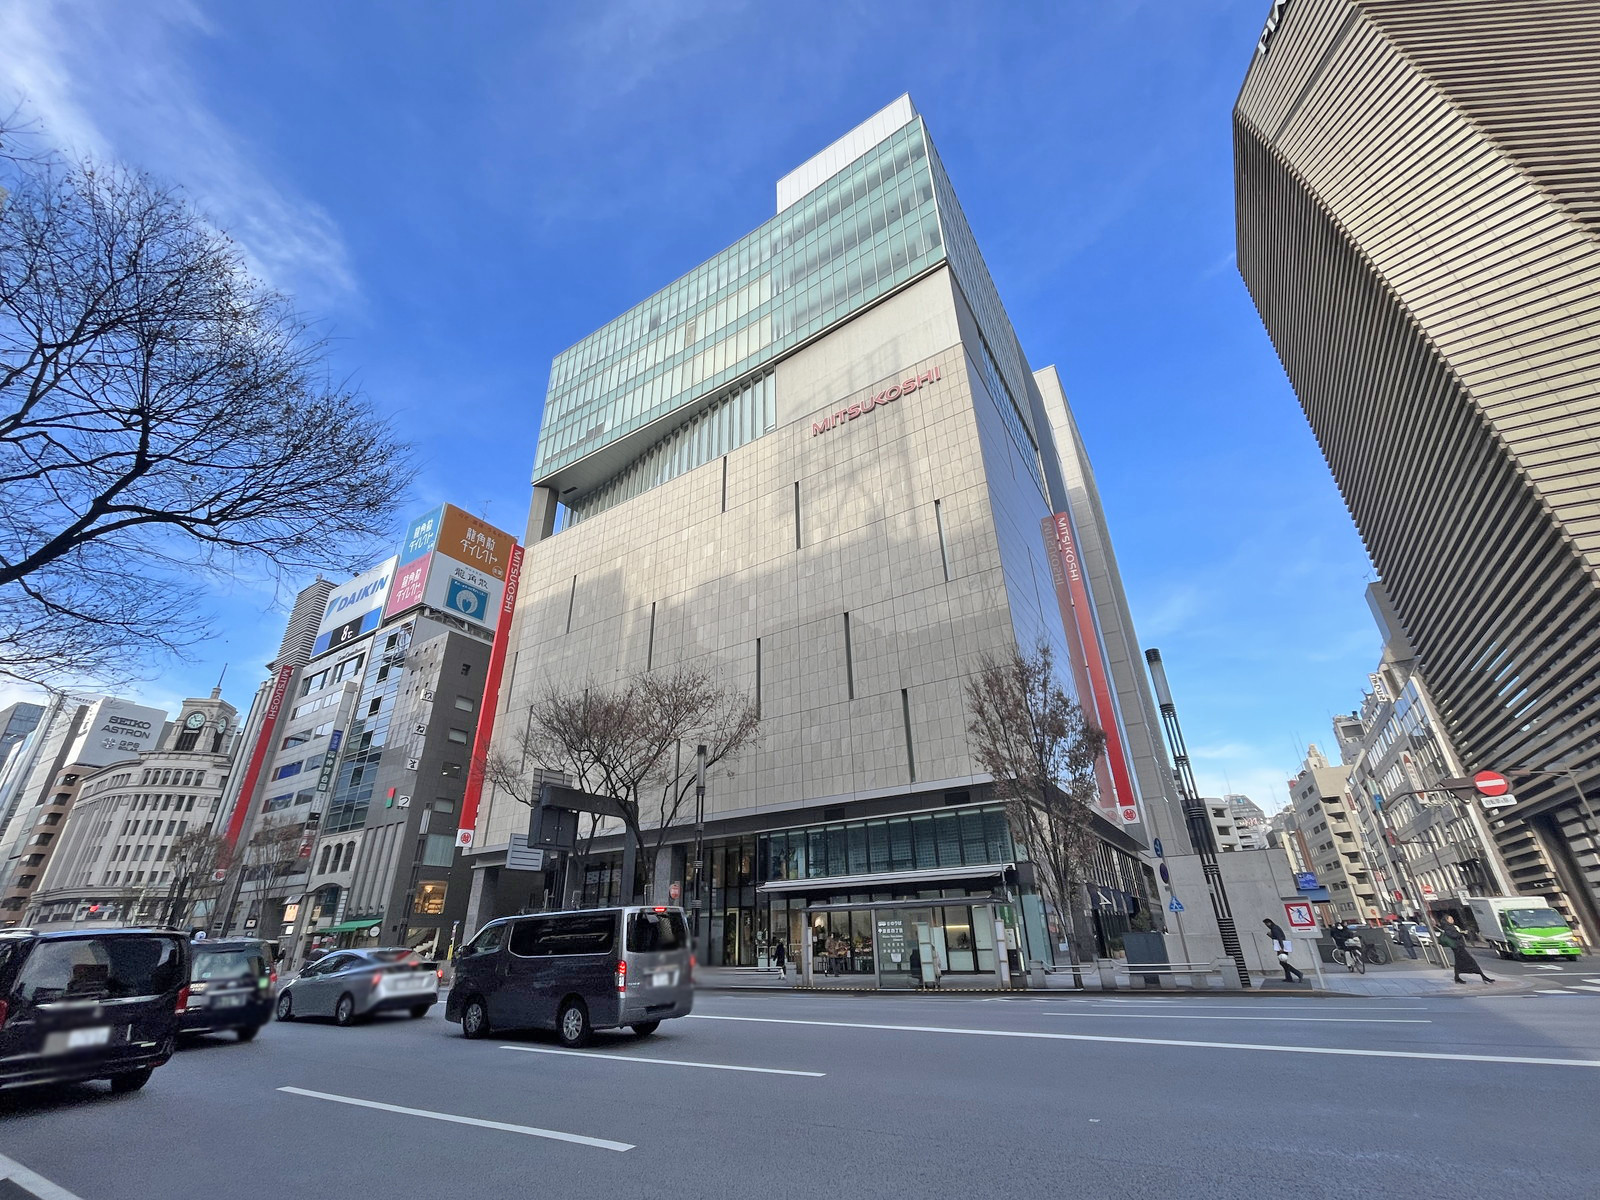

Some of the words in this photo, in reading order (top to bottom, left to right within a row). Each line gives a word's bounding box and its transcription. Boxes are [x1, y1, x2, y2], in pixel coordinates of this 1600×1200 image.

[811, 366, 942, 437] MITSUKOSHI
[336, 574, 390, 613] DAIKIN
[503, 549, 521, 614] MITSUKOSHI
[267, 668, 291, 720] MITSUKOSHI
[101, 724, 152, 740] ASTRON
[108, 715, 152, 730] SEIKO
[119, 740, 141, 749] GPS
